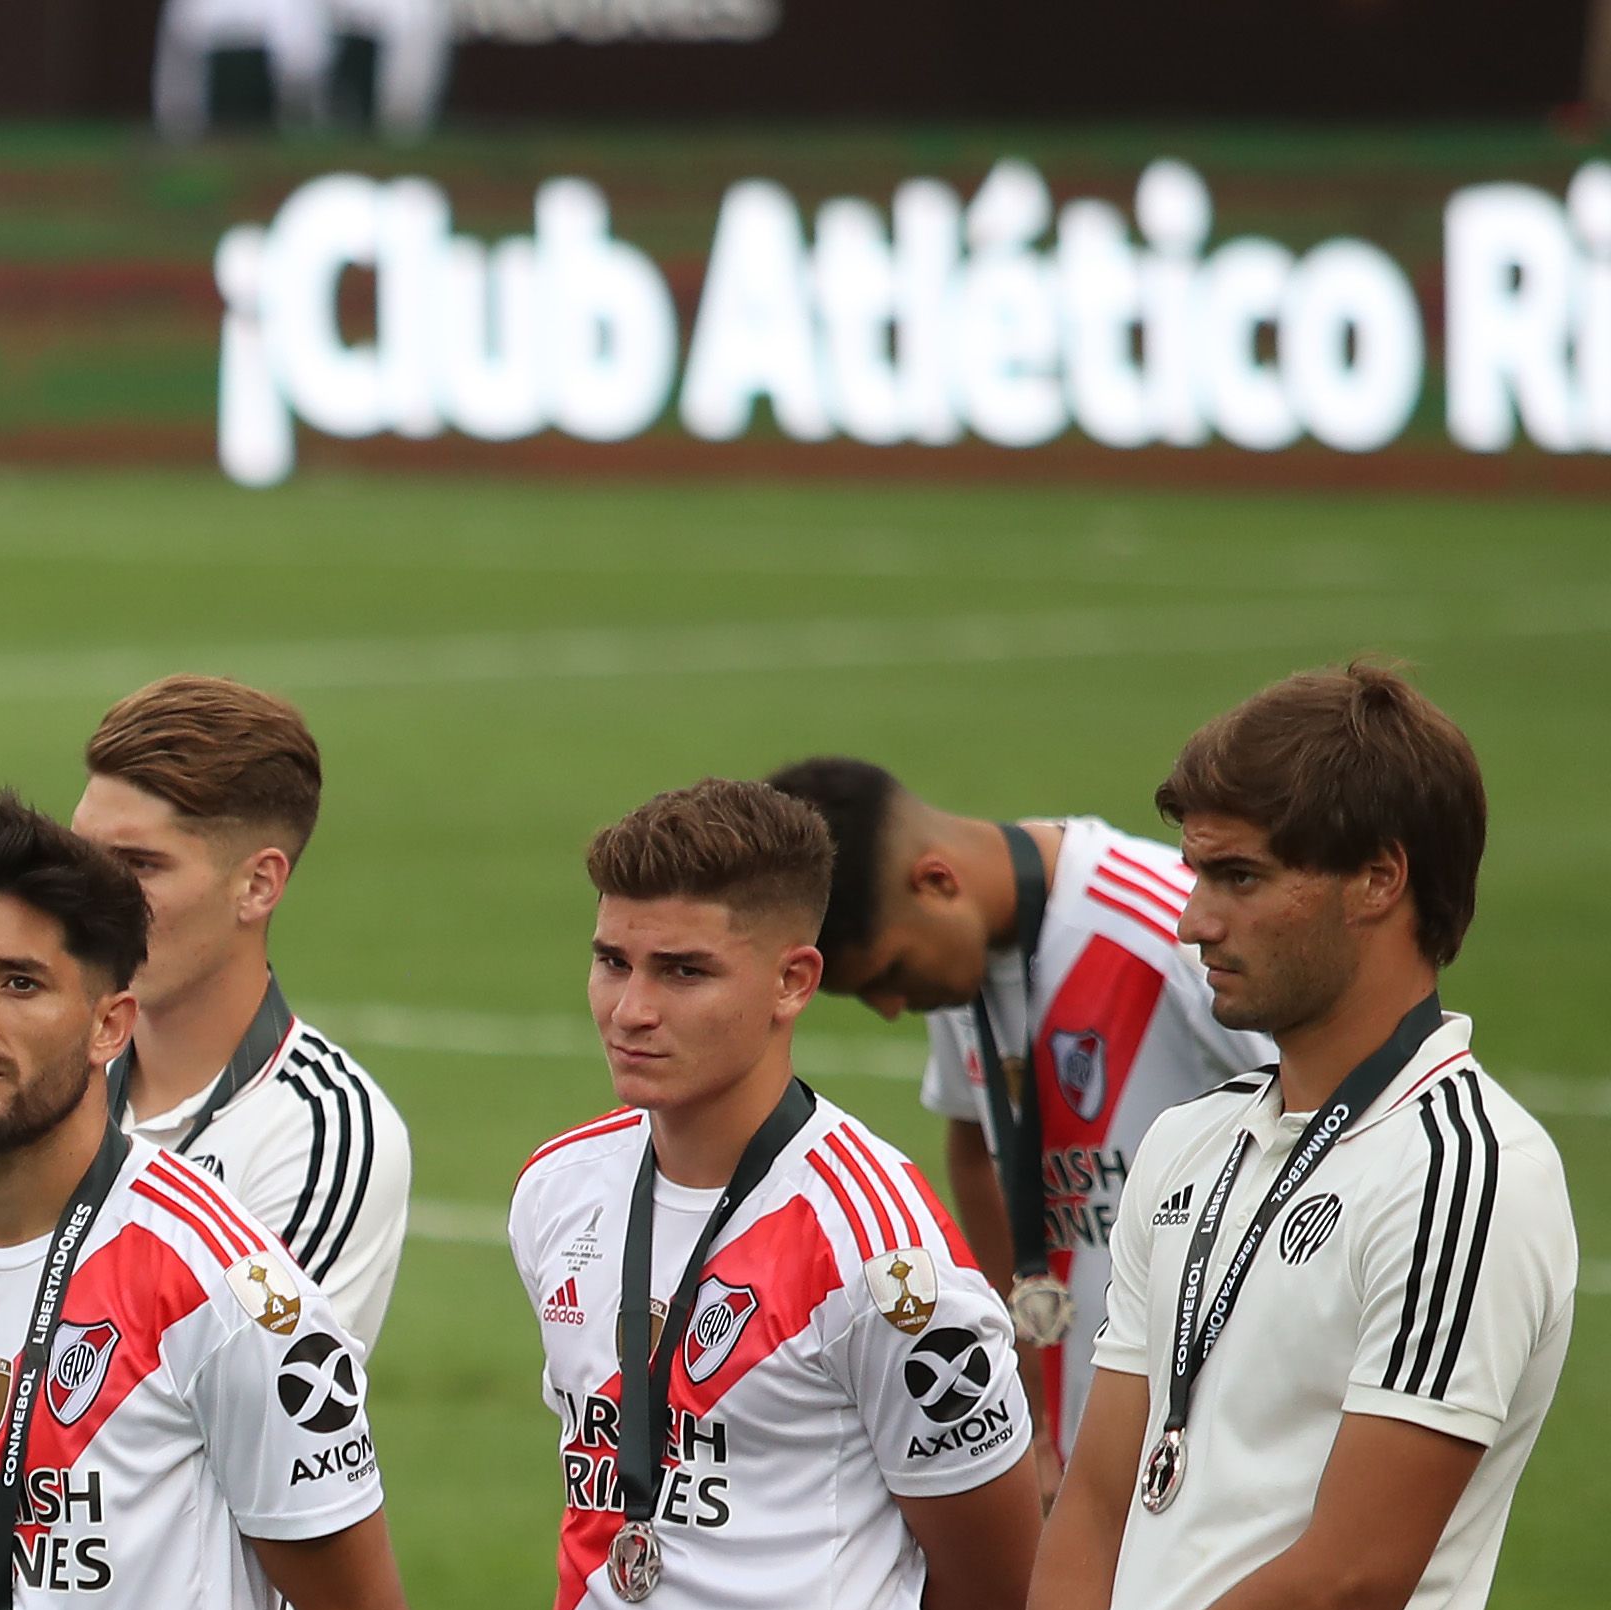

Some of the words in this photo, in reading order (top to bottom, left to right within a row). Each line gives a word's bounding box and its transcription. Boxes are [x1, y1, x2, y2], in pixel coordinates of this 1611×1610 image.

[213, 172, 679, 490] ¡Club
[677, 157, 1427, 452] Atlético
[1270, 1103, 1350, 1204] CONMEBOL
[271, 1296, 285, 1316] 4
[543, 1306, 585, 1326] adidas
[902, 1299, 917, 1315] 4
[1176, 1256, 1206, 1377] CONMEBOL
[1203, 1224, 1263, 1358] LIBERTADOR
[2, 1366, 37, 1488] CONMEBOL
[31, 1202, 93, 1346] LIBERTADORES
[290, 1433, 374, 1487] AXION
[906, 1399, 1010, 1460] AXION
[970, 1424, 1014, 1457] energy
